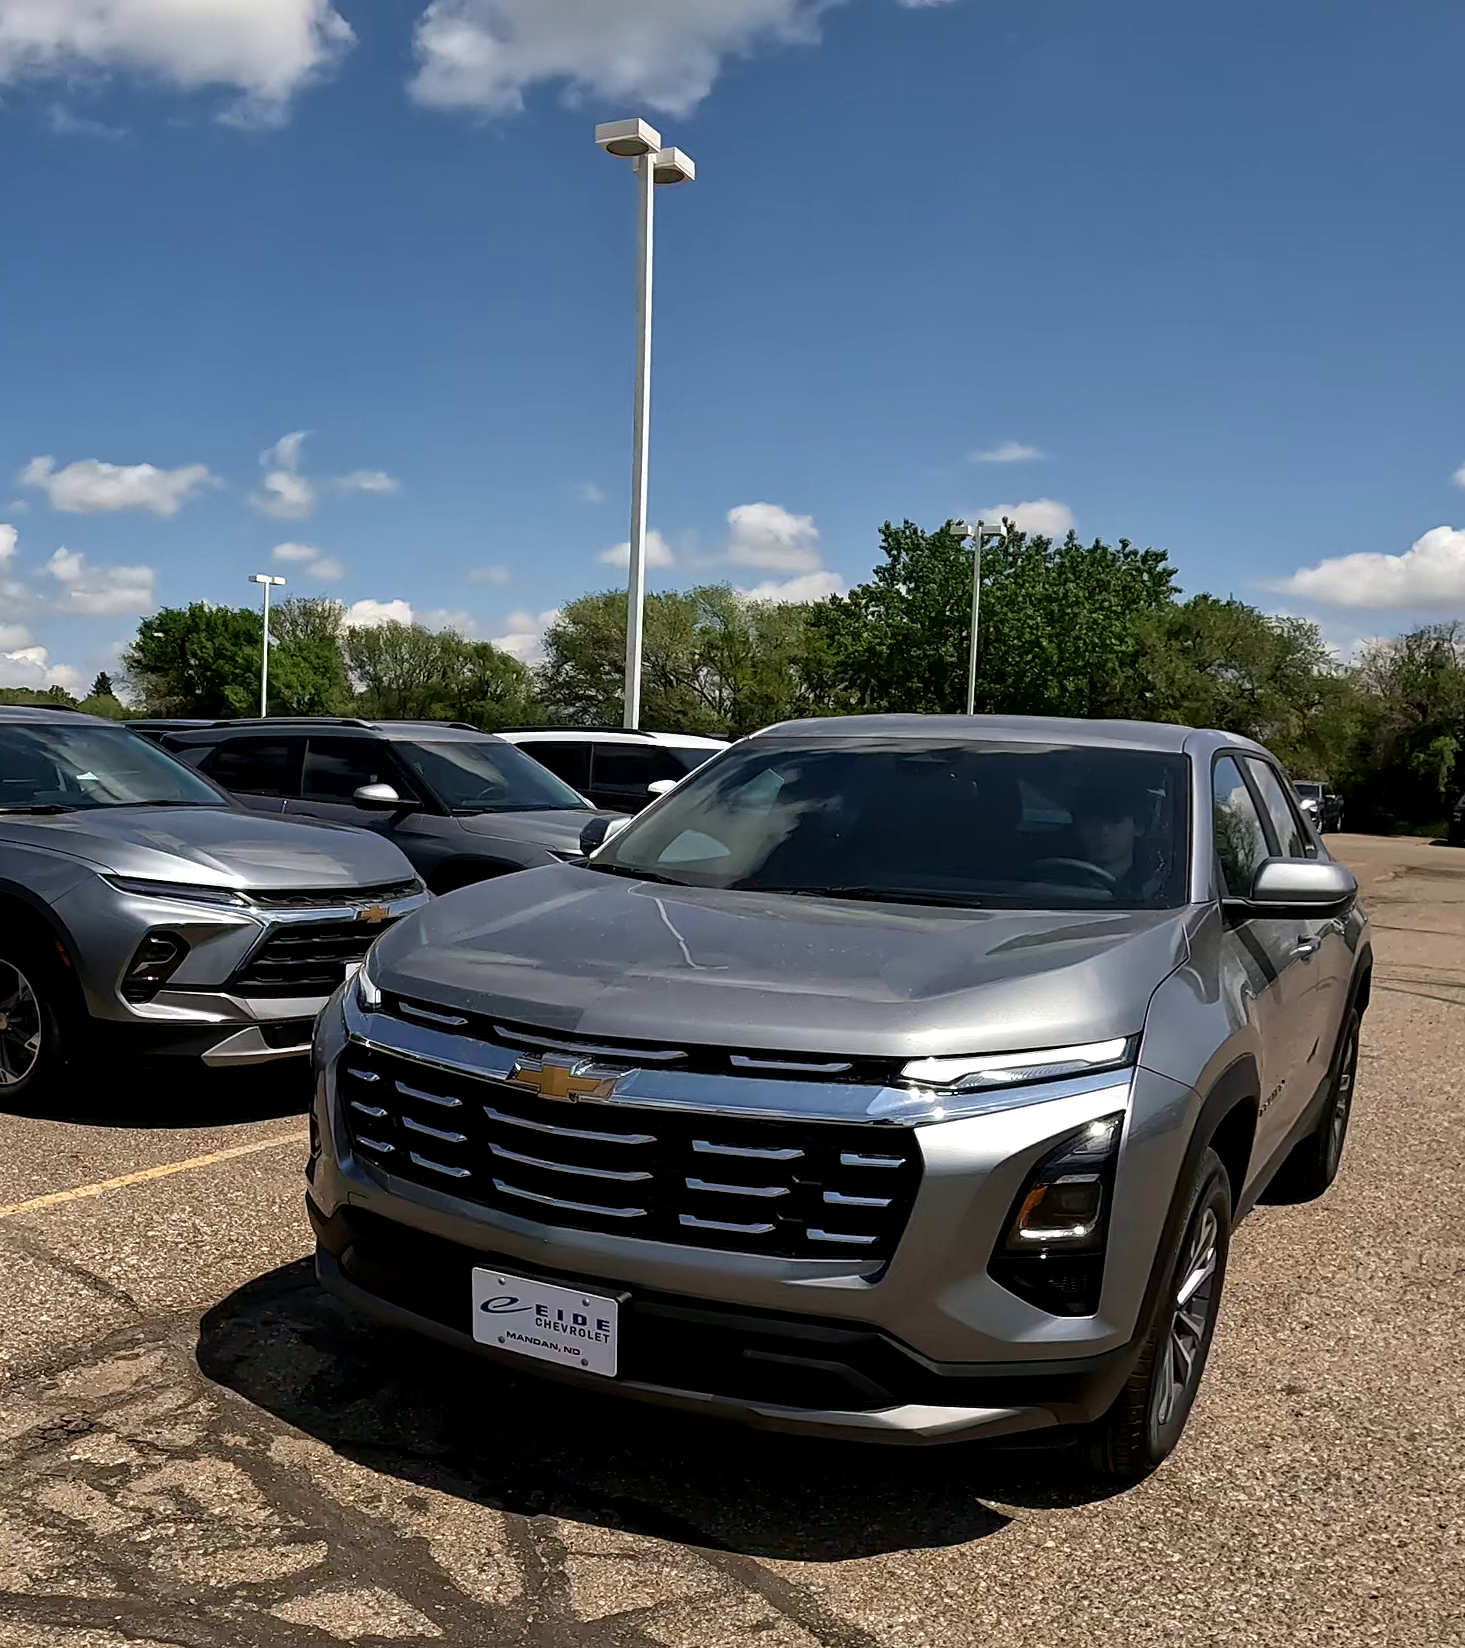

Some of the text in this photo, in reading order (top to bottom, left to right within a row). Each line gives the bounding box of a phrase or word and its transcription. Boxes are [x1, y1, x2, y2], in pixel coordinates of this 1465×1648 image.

[535, 1303, 610, 1332] EIDE
[535, 1317, 610, 1344] CHEVROLET
[506, 1331, 581, 1356] MANDAN, ND
